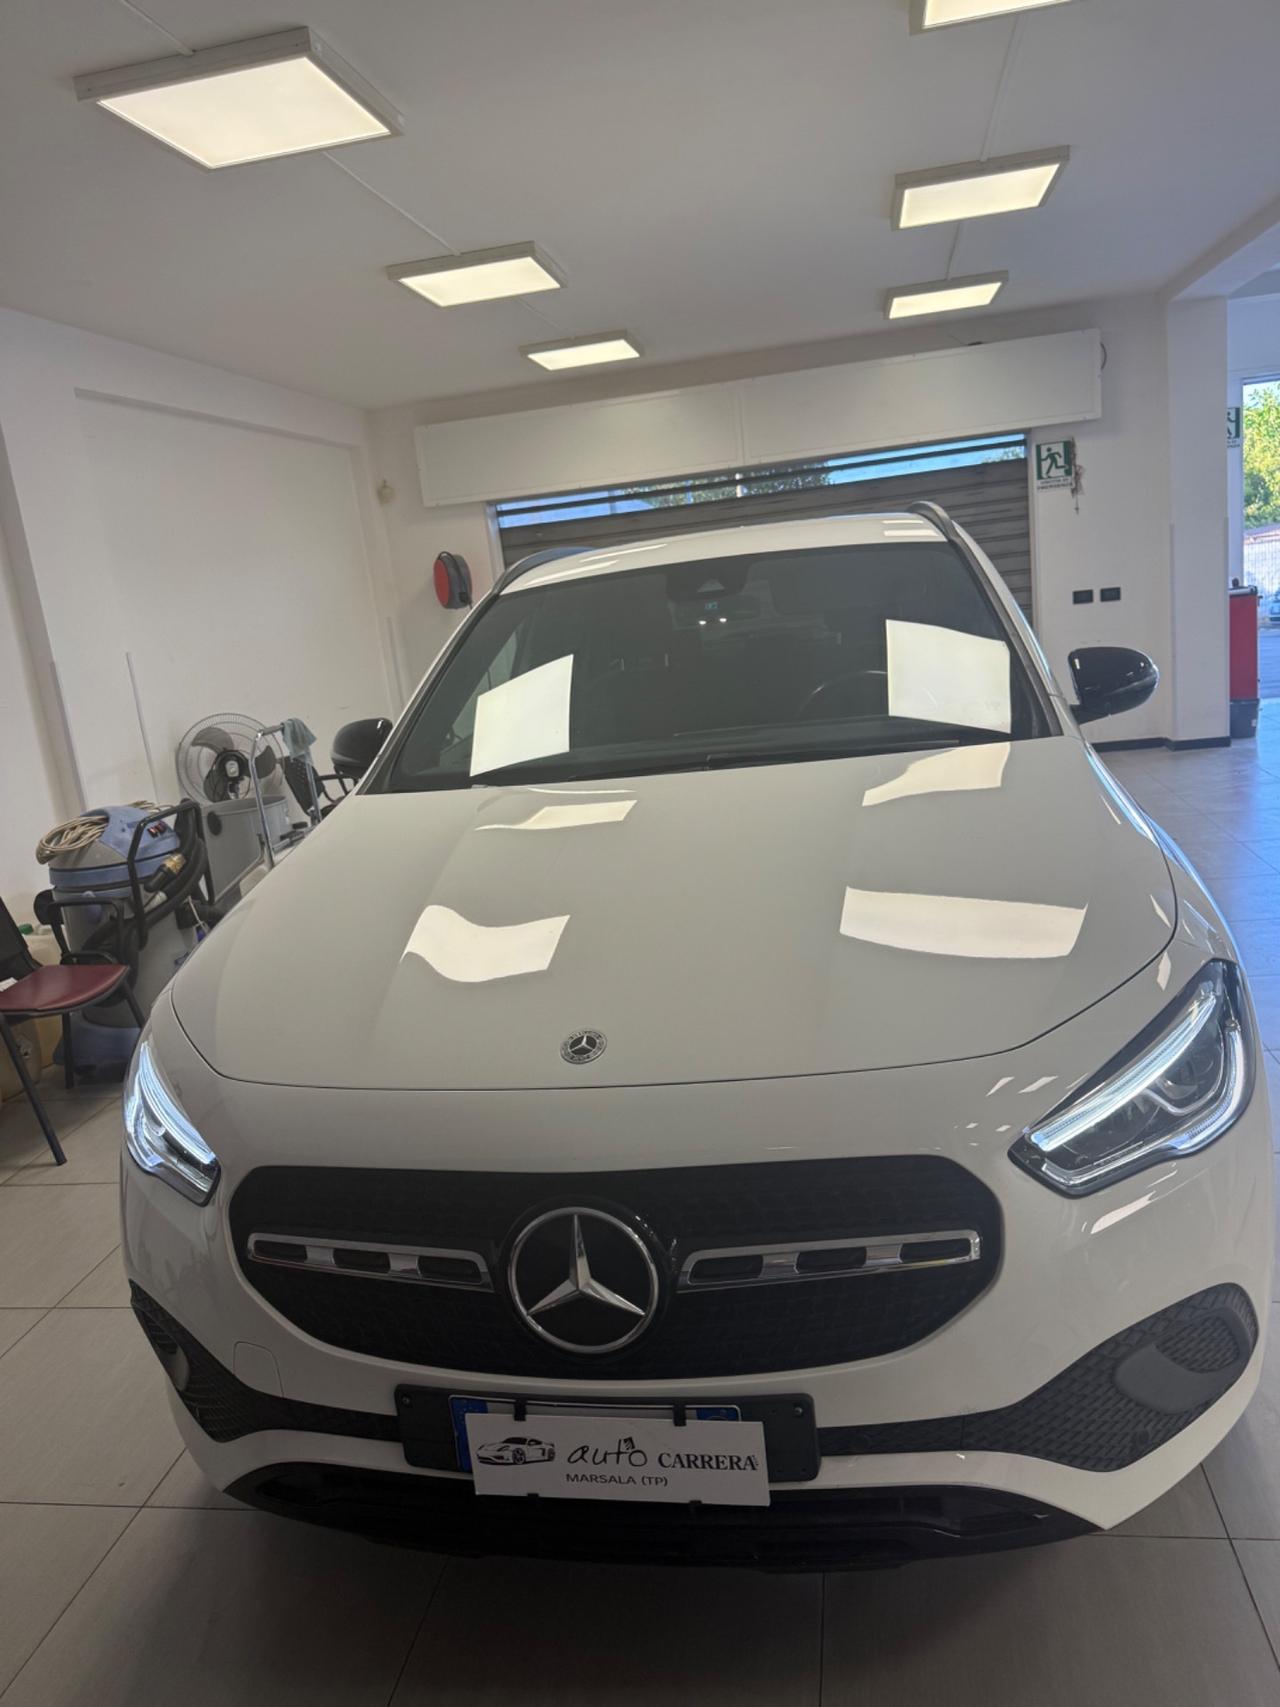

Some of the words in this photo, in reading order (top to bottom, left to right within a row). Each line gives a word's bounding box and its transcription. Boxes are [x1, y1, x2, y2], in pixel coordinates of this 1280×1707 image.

[567, 1438, 647, 1467] auto
[658, 1452, 757, 1471] CARRERA
[566, 1473, 637, 1485] MARSALA
[641, 1475, 668, 1487] (TP)
